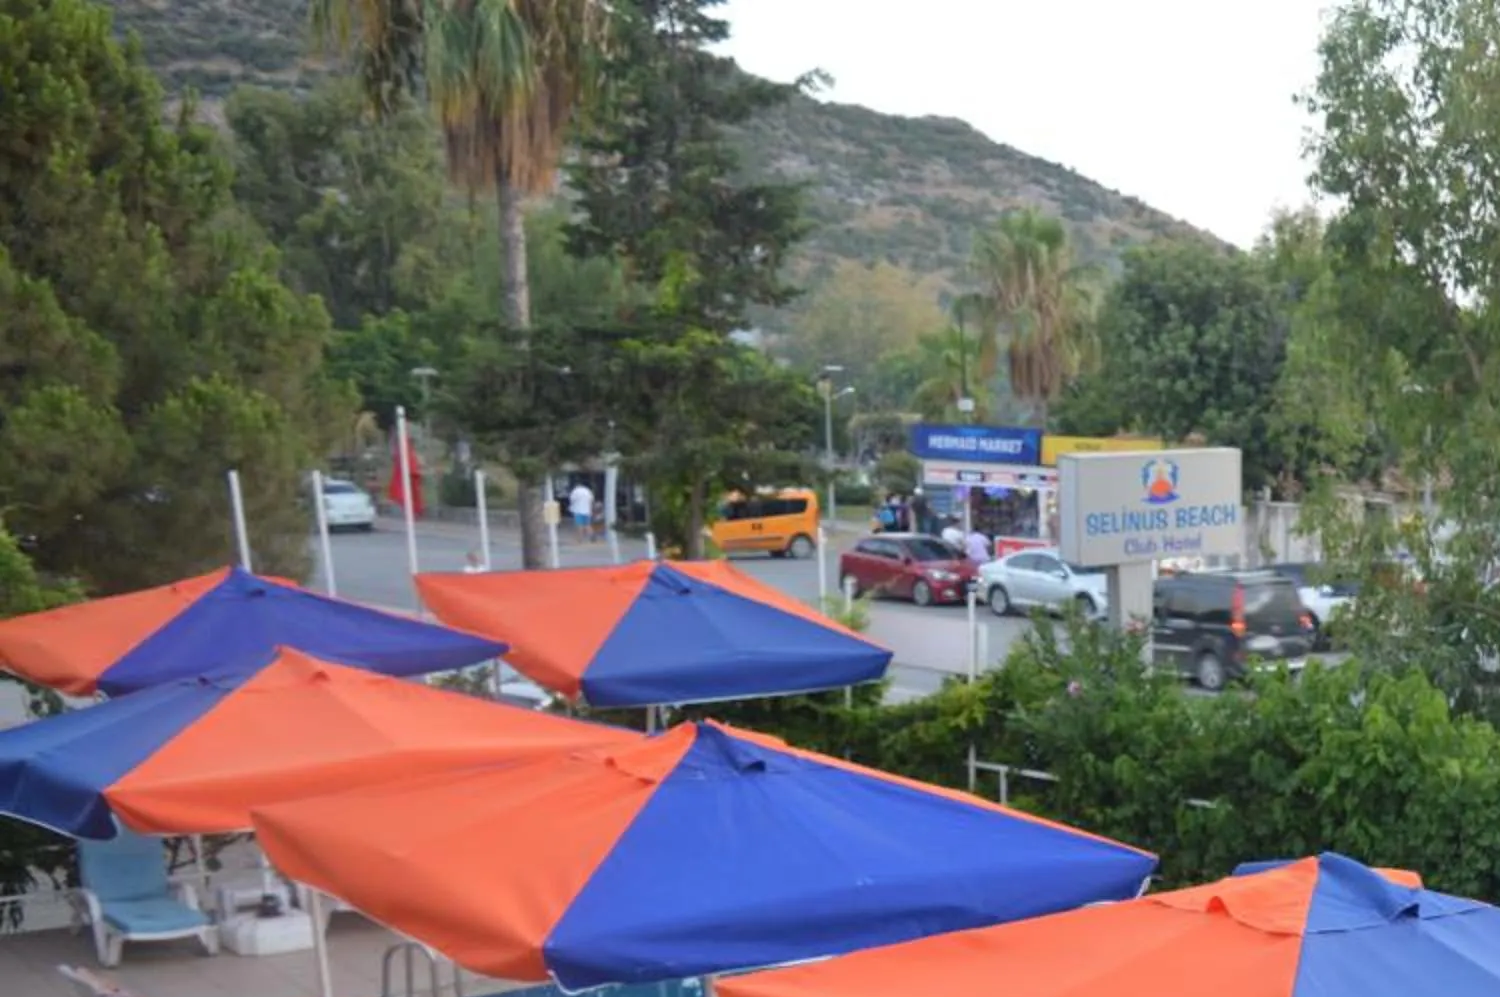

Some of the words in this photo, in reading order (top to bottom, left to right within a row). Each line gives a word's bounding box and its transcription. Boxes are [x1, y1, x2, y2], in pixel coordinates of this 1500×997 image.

[979, 437, 1023, 454] MARKET
[1175, 504, 1236, 528] BEACH
[1124, 536, 1157, 555] Club
[1163, 533, 1202, 552] Hotel
